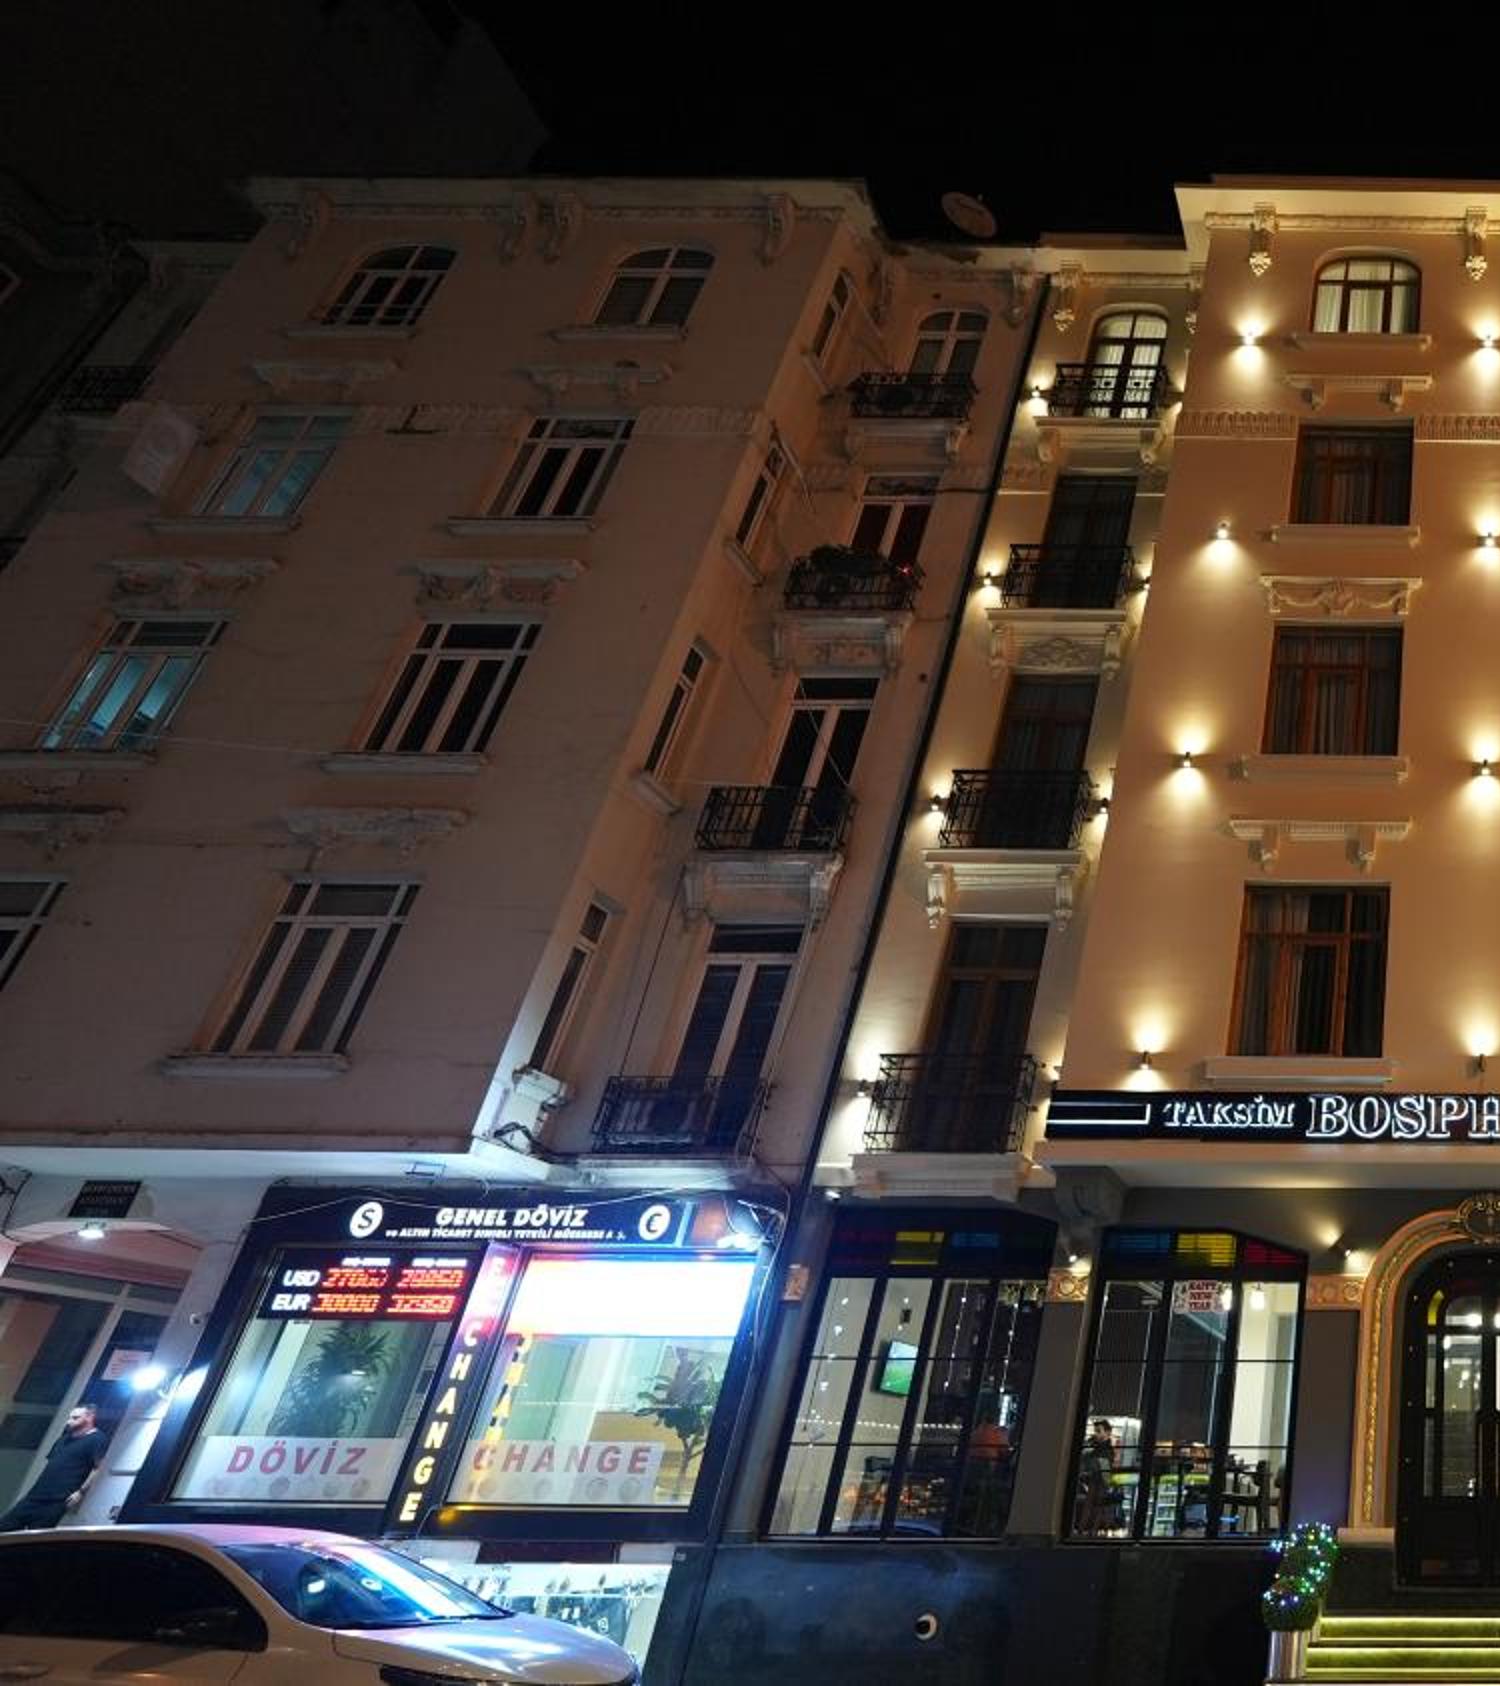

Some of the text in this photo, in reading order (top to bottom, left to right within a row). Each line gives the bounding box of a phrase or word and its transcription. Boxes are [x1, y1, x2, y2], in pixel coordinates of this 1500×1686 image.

[435, 1204, 588, 1227] GENEL DÖVİZ
[283, 1270, 320, 1287] USD
[271, 1294, 311, 1311] EUR
[399, 1321, 482, 1522] CHANGE
[226, 1441, 367, 1476] DÖVİZ
[472, 1444, 652, 1474] CHANGE
